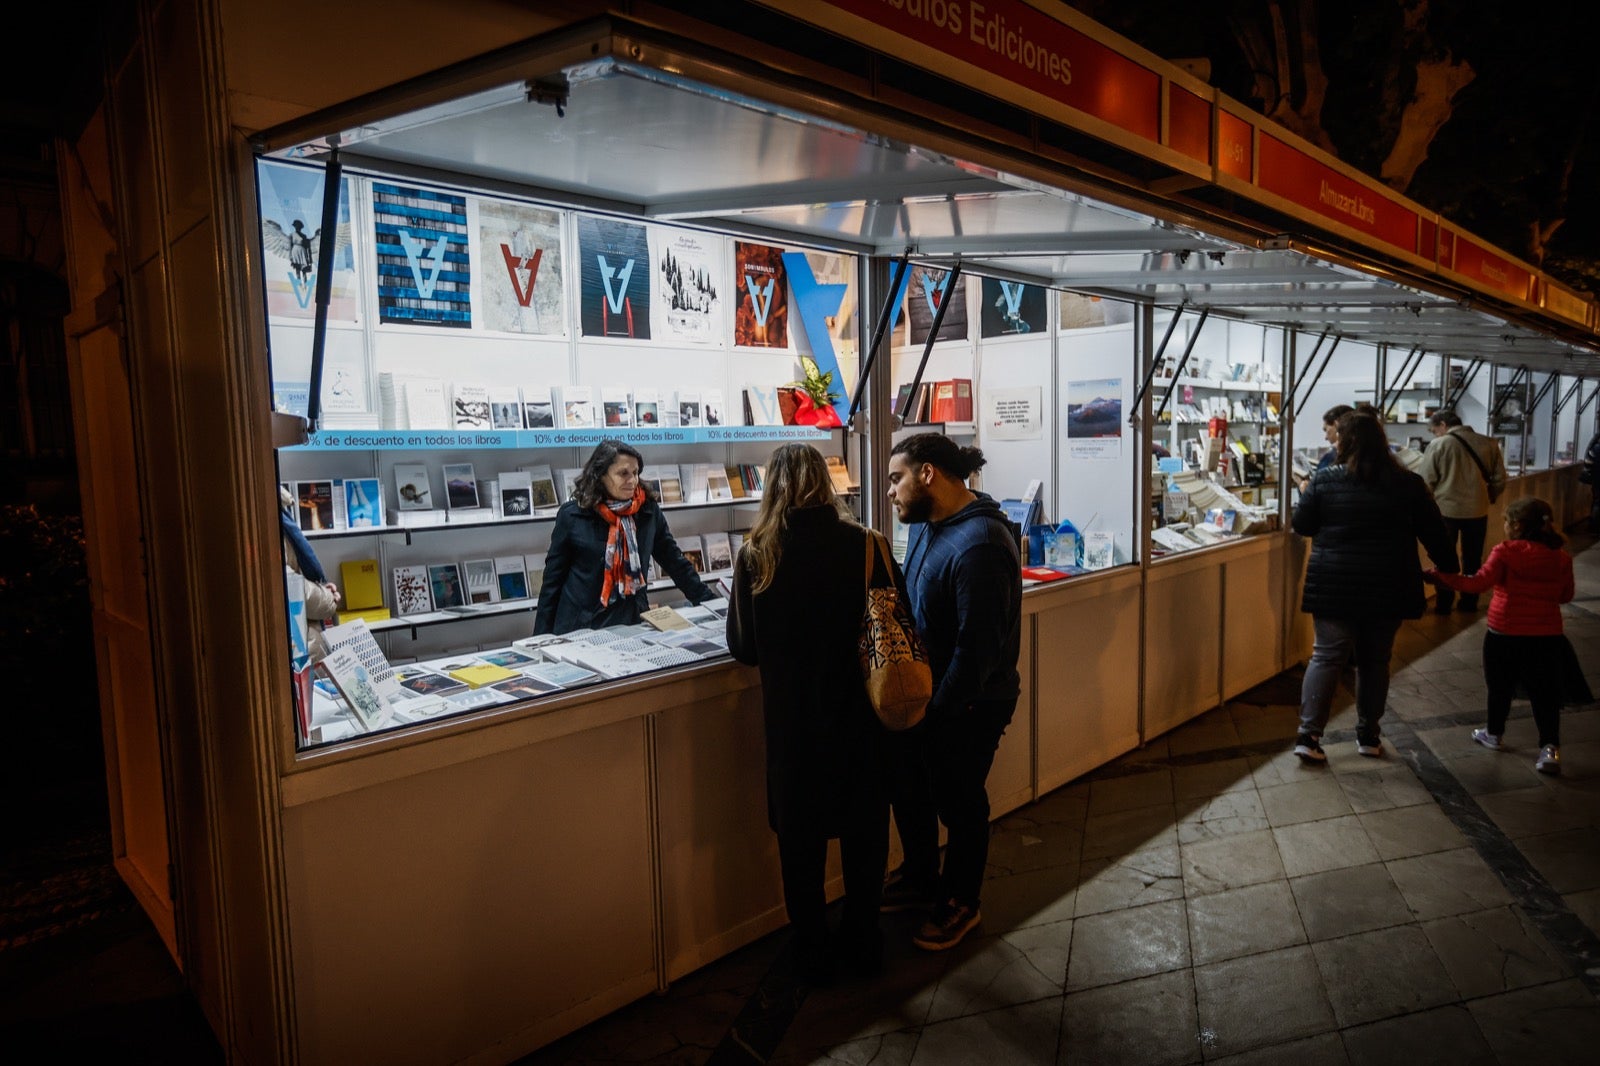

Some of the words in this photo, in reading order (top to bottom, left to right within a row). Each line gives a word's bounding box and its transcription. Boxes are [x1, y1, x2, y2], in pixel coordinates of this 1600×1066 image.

[970, 1, 1072, 86] Ediciones
[324, 435, 340, 446] de
[344, 434, 404, 446] descuento
[408, 436, 421, 445] en
[425, 434, 455, 445] todos
[458, 434, 472, 445] los
[475, 433, 501, 444] libros
[534, 434, 551, 444] 10%
[554, 434, 565, 443] de
[627, 432, 649, 441] todos
[651, 431, 662, 441] los
[664, 431, 684, 440] libros
[708, 430, 721, 439] 10%
[723, 430, 732, 438] de
[734, 429, 767, 439] descuento
[779, 429, 796, 438] todos
[797, 428, 805, 437] los
[807, 428, 822, 437] libros
